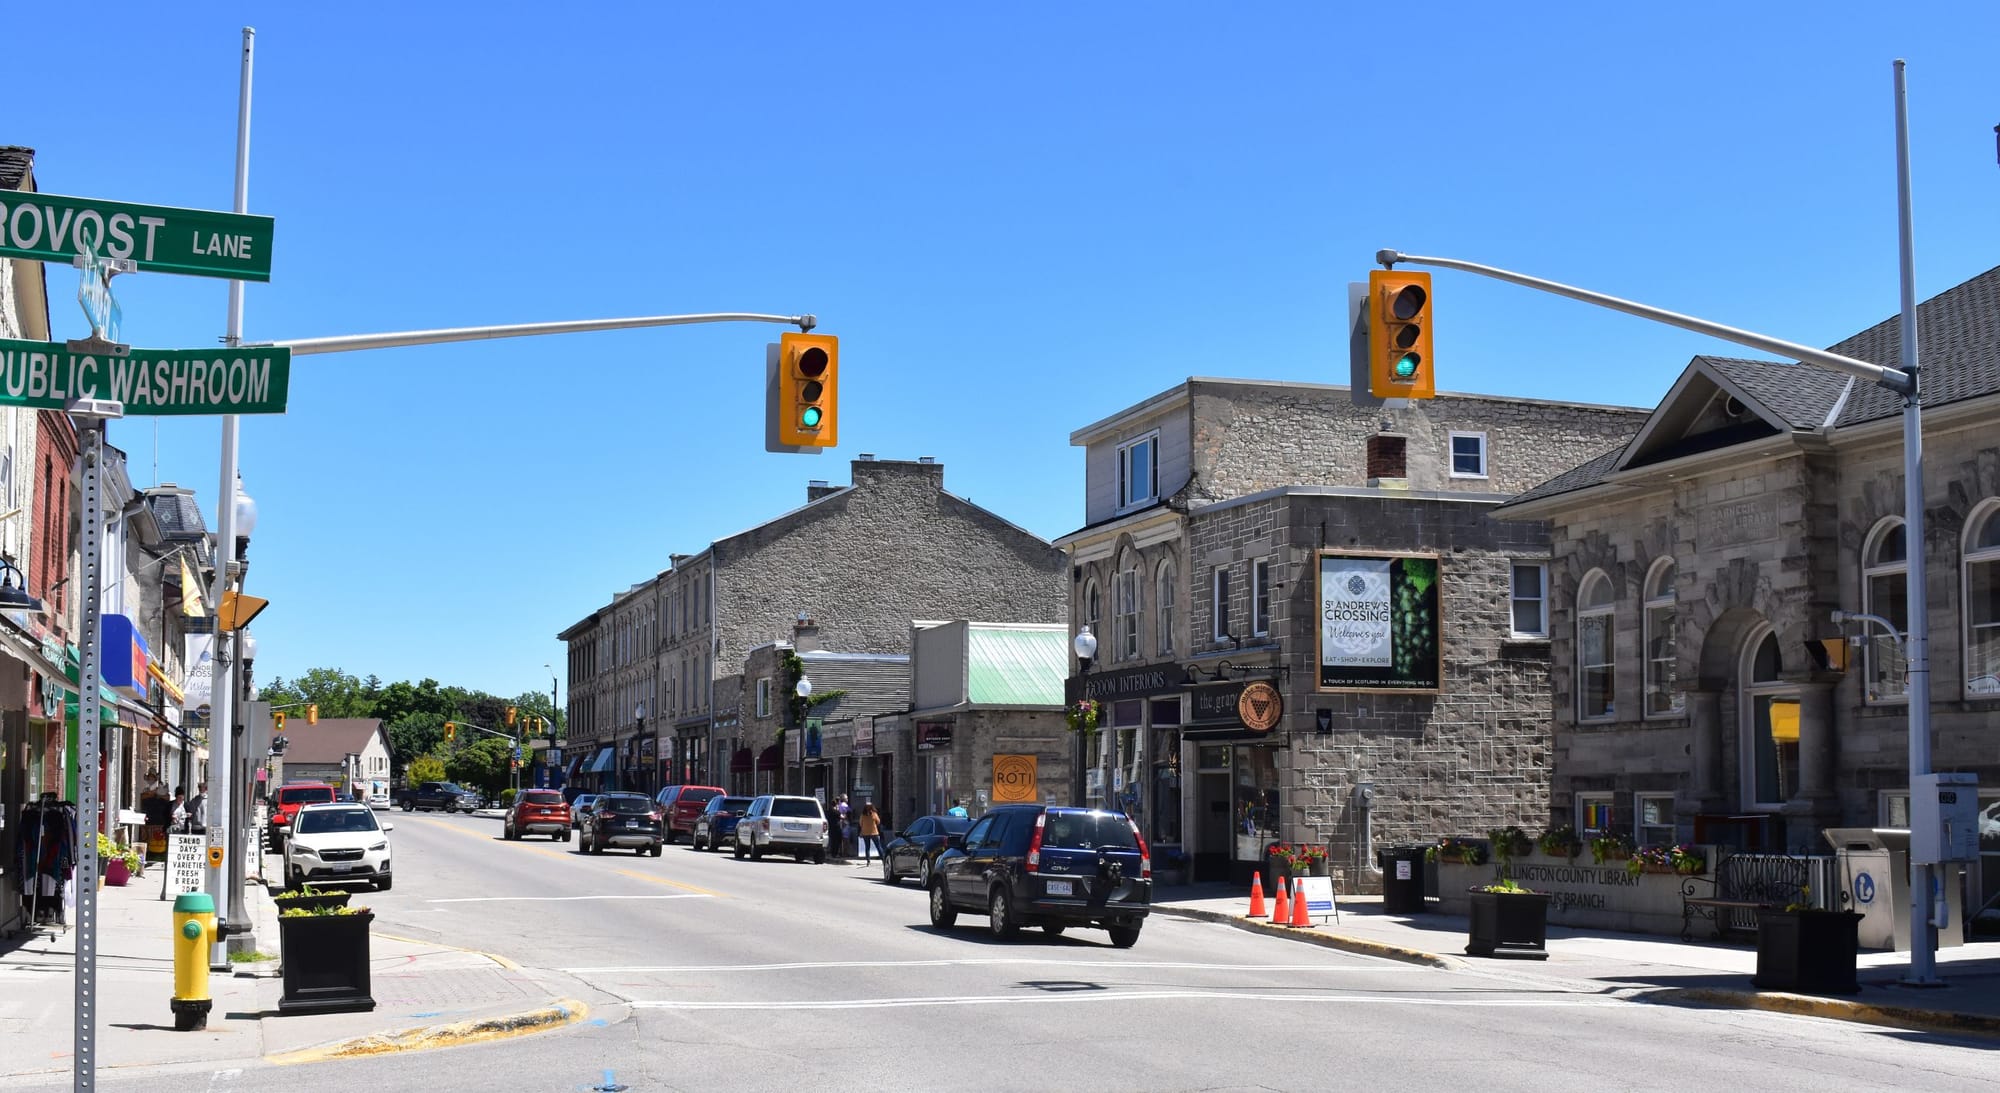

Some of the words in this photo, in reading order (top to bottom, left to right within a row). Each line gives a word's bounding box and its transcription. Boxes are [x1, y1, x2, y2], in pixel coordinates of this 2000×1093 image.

[0, 202, 166, 261] OVOST
[193, 230, 252, 259] LANE
[0, 351, 98, 399] UBLIC
[108, 358, 271, 406] WASHROOM
[1336, 601, 1389, 610] ANDREW'S
[1325, 609, 1389, 622] CROSSING
[1329, 625, 1370, 639] Welcomes
[1371, 630, 1385, 644] you
[1120, 671, 1165, 693] INTERIORS
[1216, 693, 1238, 713] grap
[997, 772, 1032, 785] ROTI
[177, 853, 194, 861] OVER
[197, 853, 202, 861] 7
[180, 845, 197, 853] DAYS
[177, 869, 199, 877] FRESH
[1494, 863, 1555, 881] WLLINGTON
[1557, 868, 1598, 884] COUNTY
[1599, 871, 1641, 887] LIBRARY
[1564, 892, 1605, 909] BRANCH
